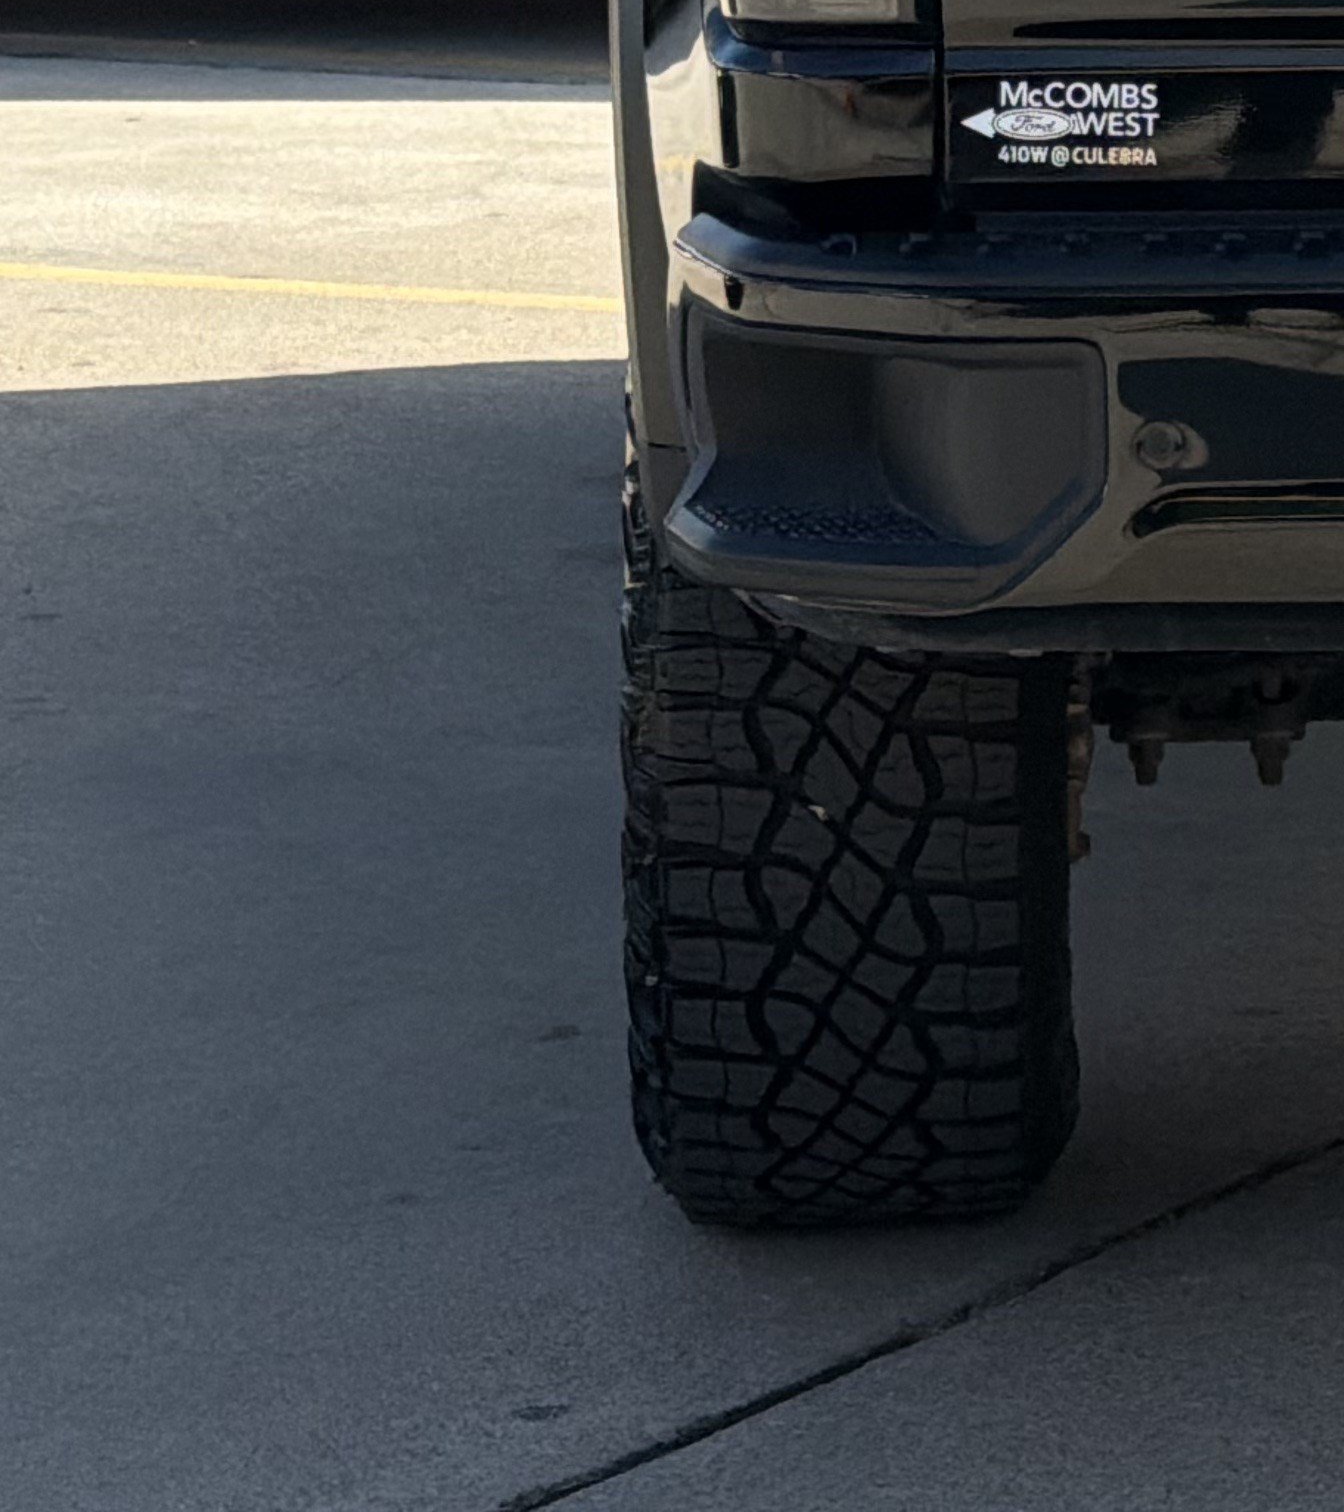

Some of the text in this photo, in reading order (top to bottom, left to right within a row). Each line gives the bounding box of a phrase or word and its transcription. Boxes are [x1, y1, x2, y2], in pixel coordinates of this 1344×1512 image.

[1000, 81, 1159, 109] McCOMBS
[1078, 112, 1161, 136] WEST
[1072, 146, 1158, 166] CULEBRA
